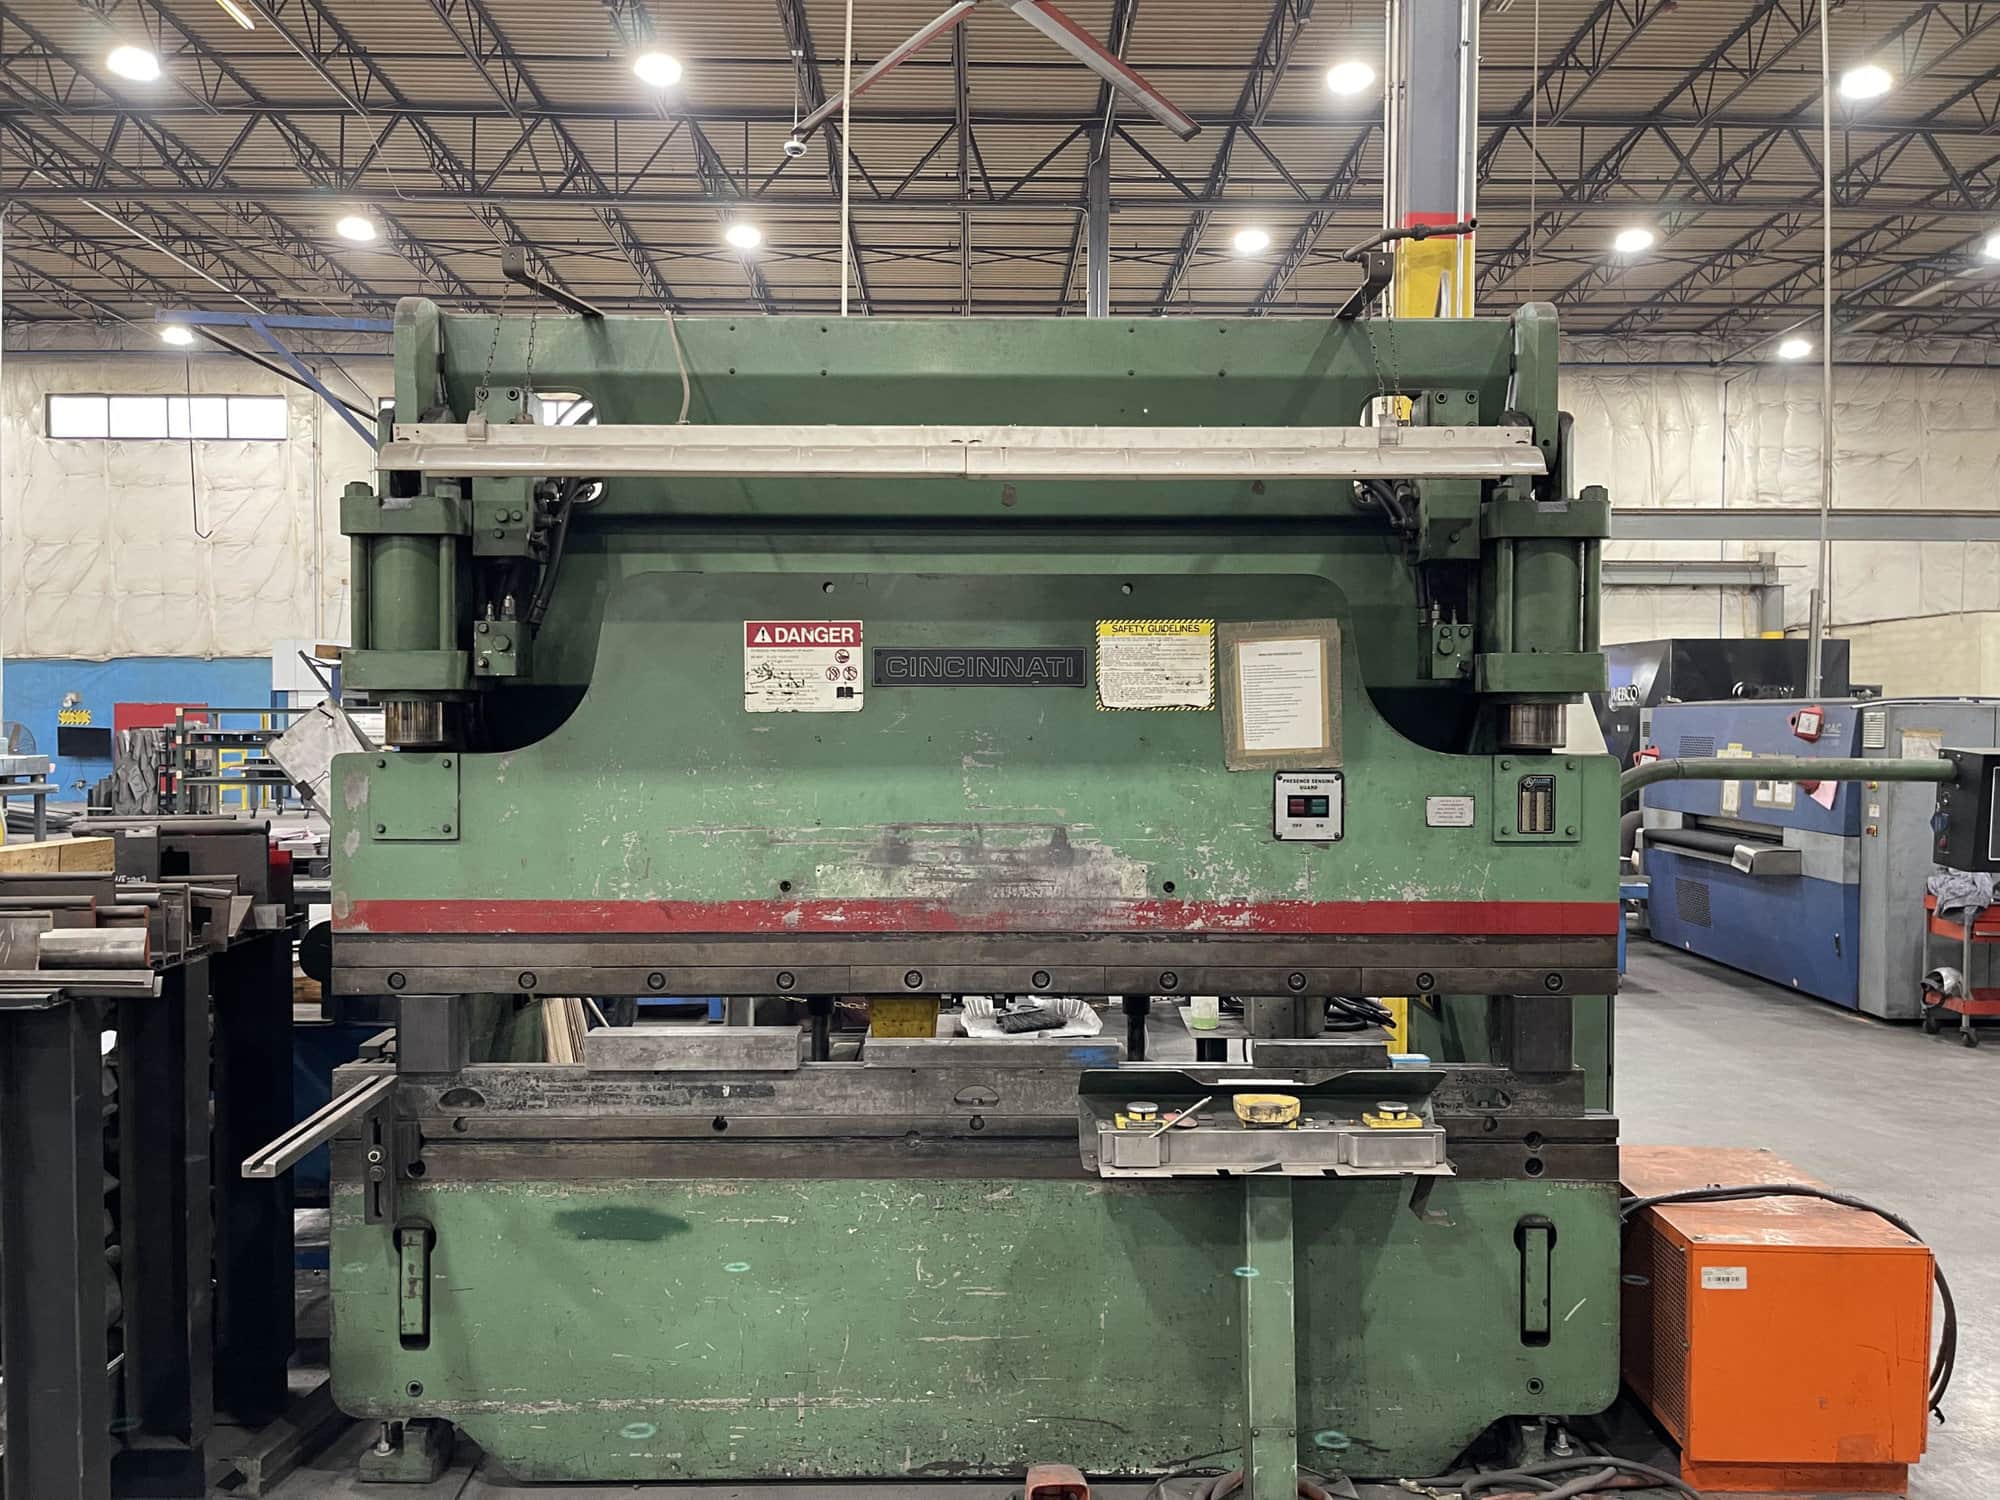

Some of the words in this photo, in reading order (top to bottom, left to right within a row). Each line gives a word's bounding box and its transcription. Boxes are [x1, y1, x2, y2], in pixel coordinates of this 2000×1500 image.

[774, 627, 854, 643] DANGER
[1112, 624, 1145, 633] SAFETY
[1147, 624, 1200, 633] GUIDELINES
[886, 656, 1073, 678] CINCINNATI
